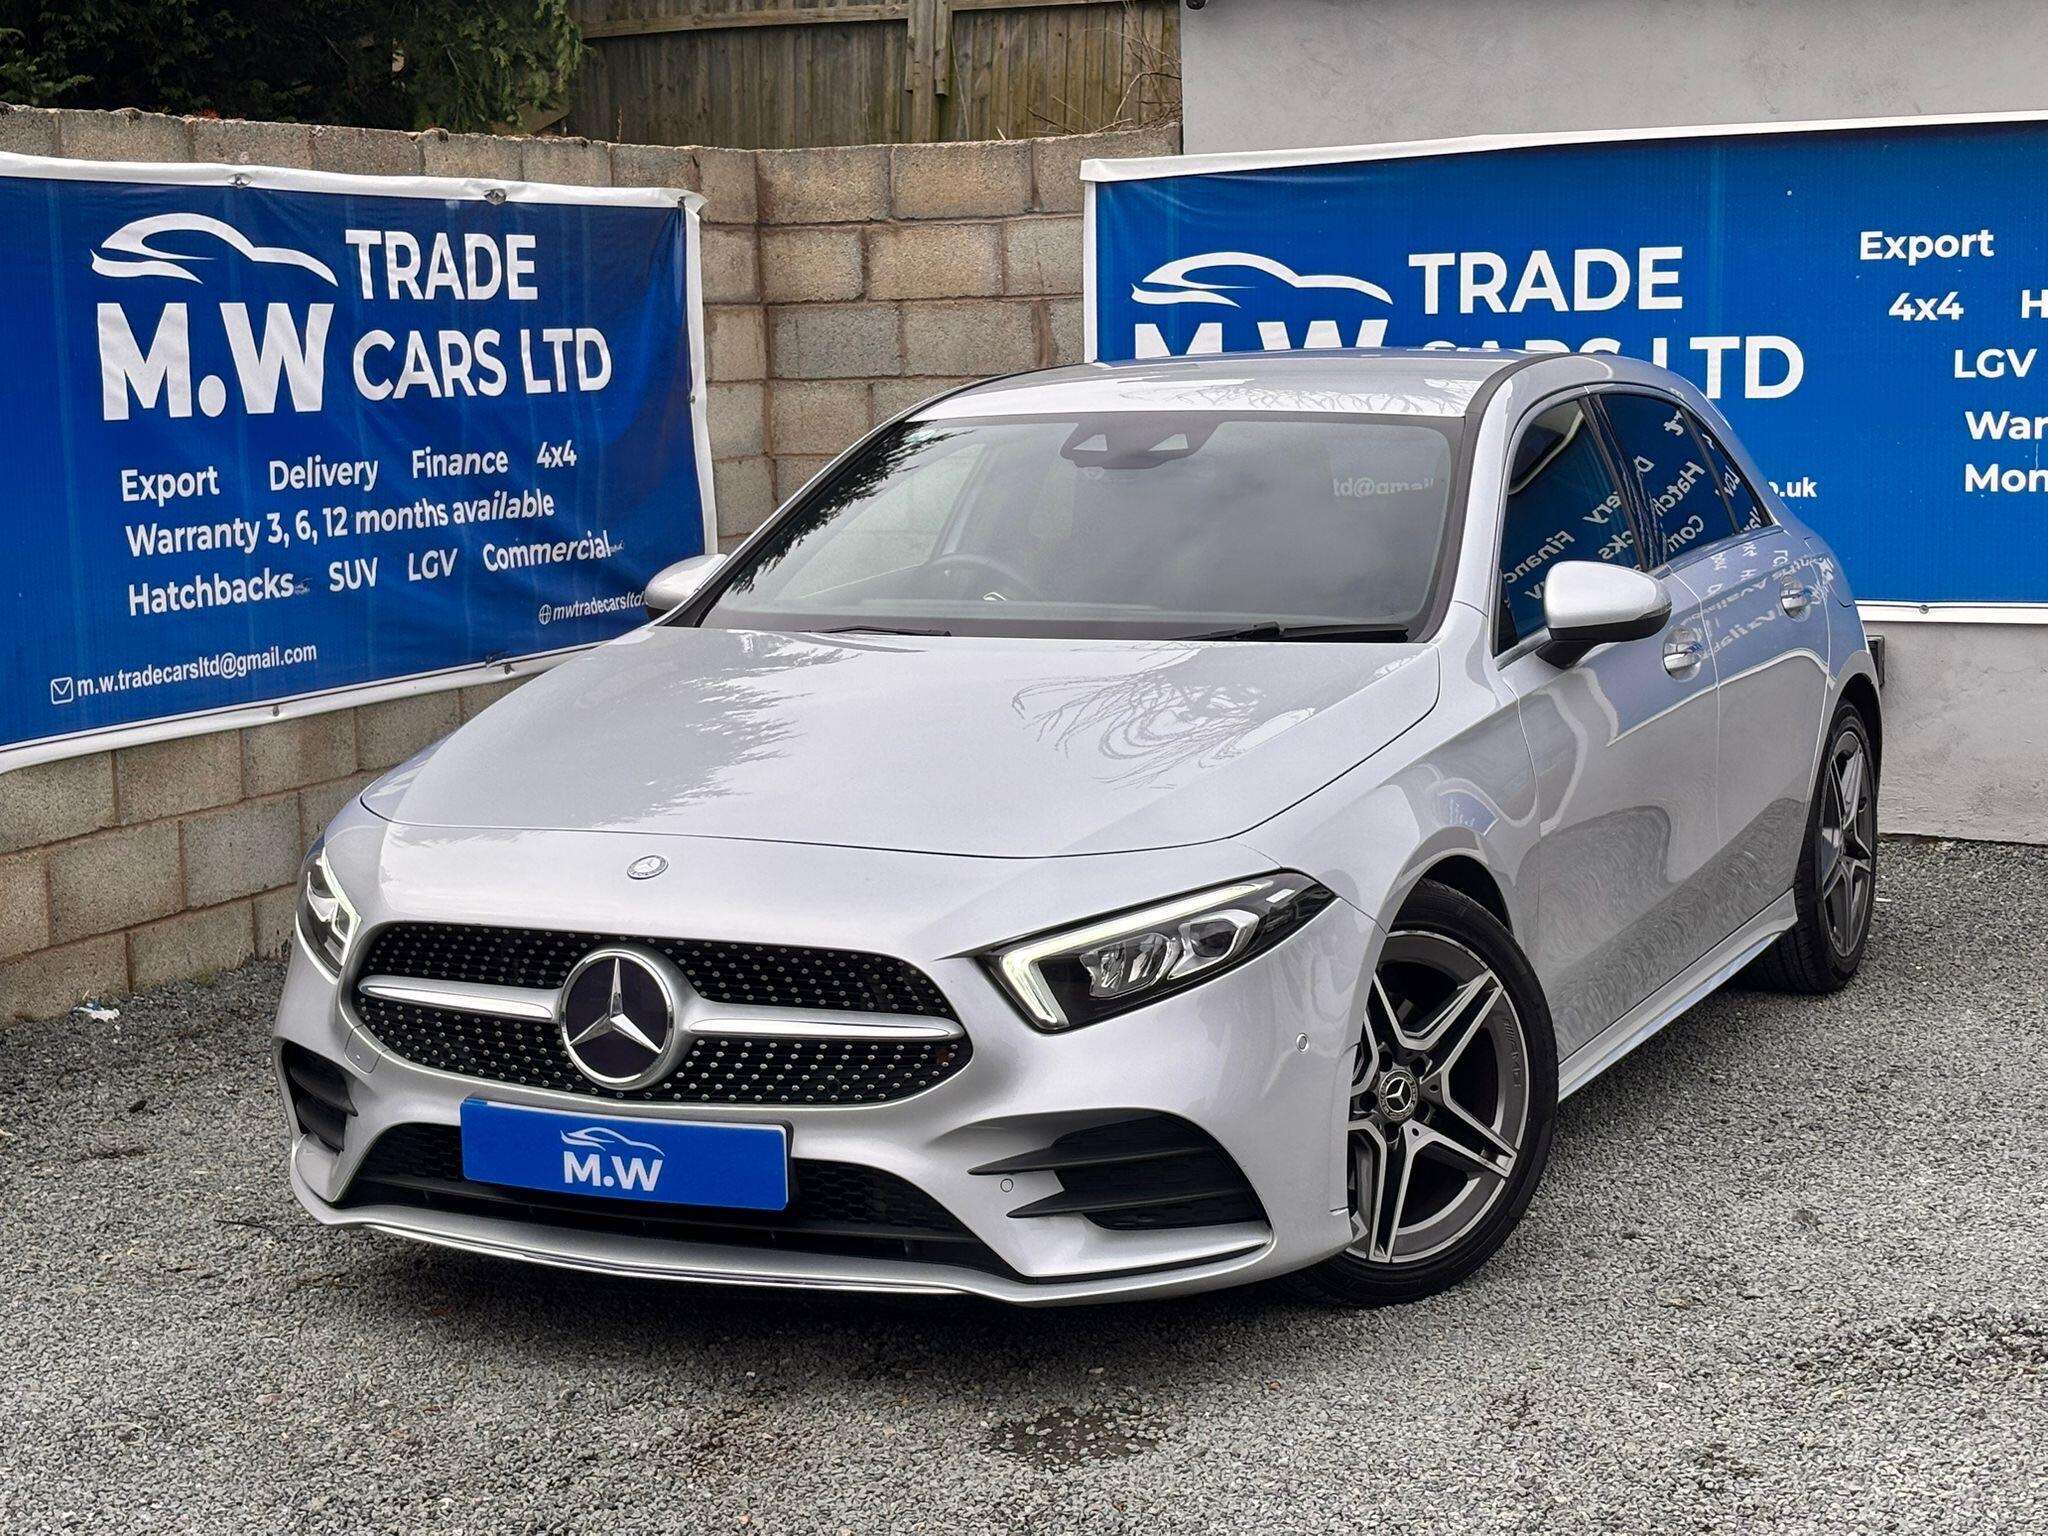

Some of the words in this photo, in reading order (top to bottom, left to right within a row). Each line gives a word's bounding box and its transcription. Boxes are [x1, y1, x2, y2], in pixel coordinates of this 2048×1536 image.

[345, 229, 538, 300] TRADE
[1860, 229, 1995, 266] Export
[1408, 246, 1684, 314] TRADE
[1888, 291, 1964, 321] 4x4
[97, 302, 335, 421] M.W
[352, 328, 507, 401] CARS
[520, 327, 612, 394] LTD
[1954, 348, 2038, 379] LGV
[1964, 411, 2048, 440] War
[121, 466, 220, 507] Export
[269, 454, 379, 492] Delivery
[412, 446, 509, 479] Finance
[536, 439, 577, 468] 4x4
[1965, 463, 2048, 493] Mon
[124, 517, 261, 558] Warranty
[266, 512, 290, 549] 3,
[294, 509, 318, 545] 6,
[322, 506, 348, 538] 12
[355, 498, 449, 535] months
[453, 488, 555, 525] available
[129, 567, 294, 616] Hatchbacks
[329, 557, 378, 592] SUV
[408, 548, 458, 581] LGV
[482, 529, 612, 571] Commercial
[77, 644, 318, 697] m.w.tradecarsltd@gmail.com
[563, 1151, 663, 1191] M.W
